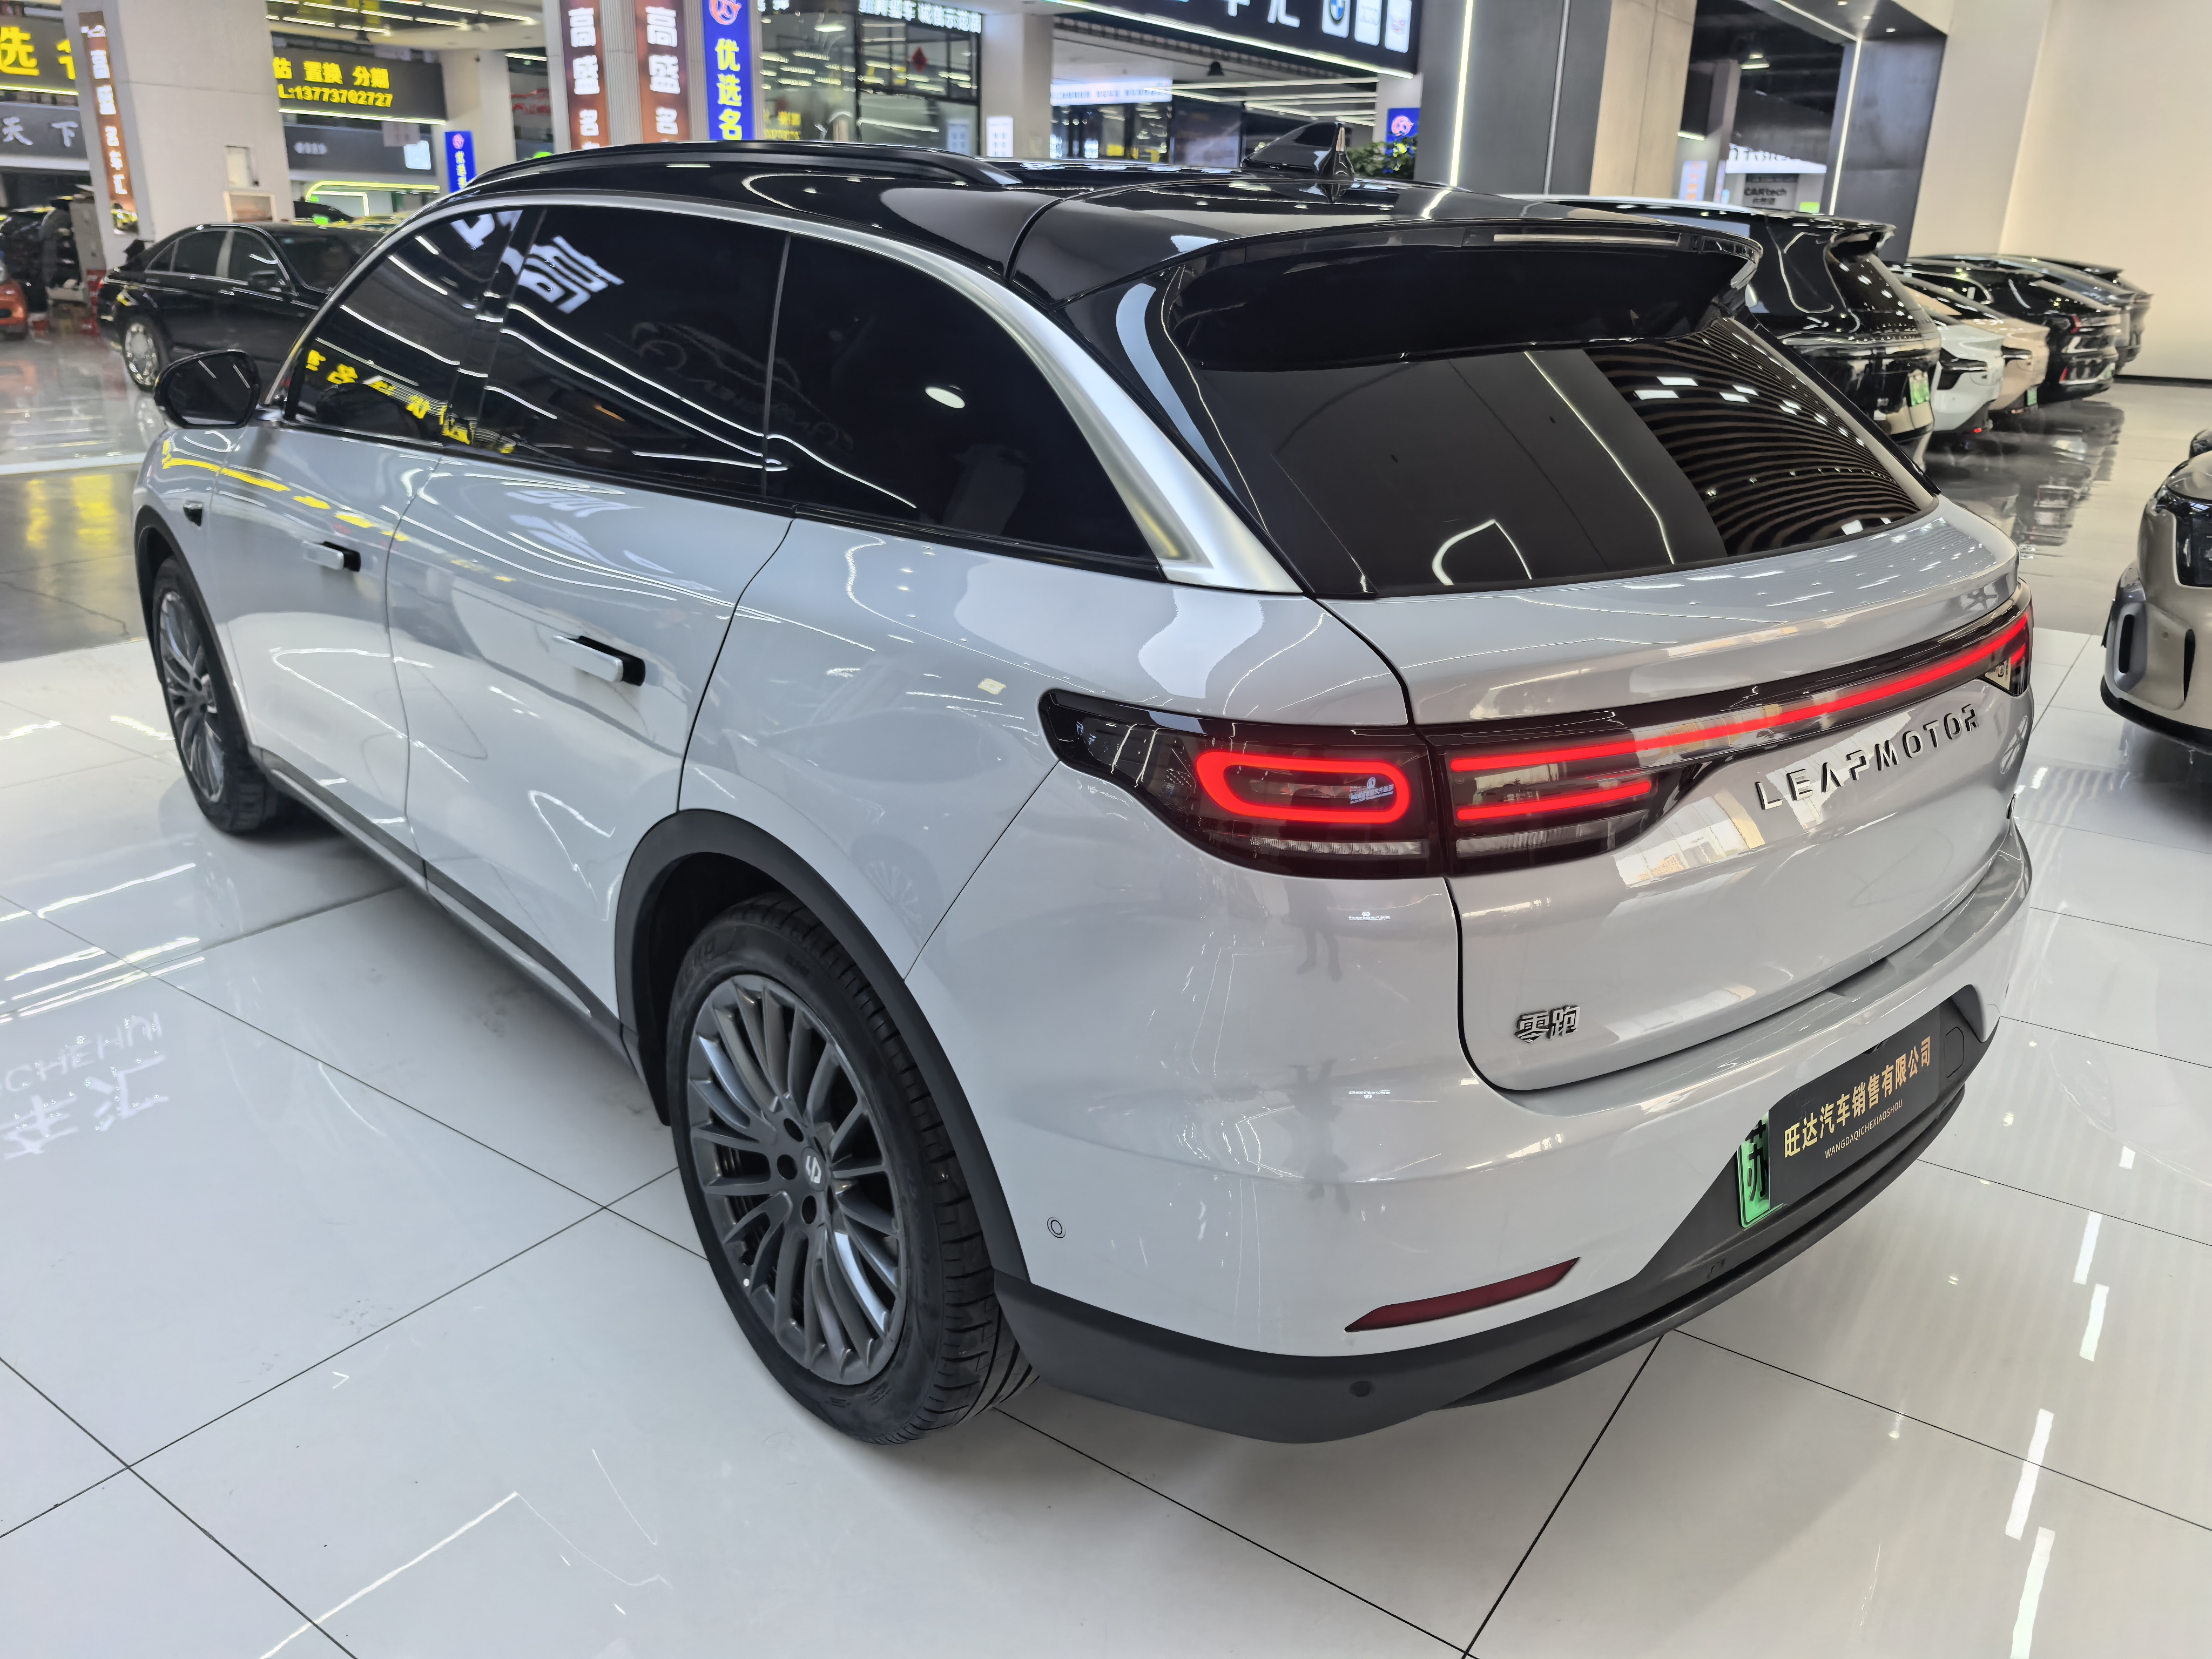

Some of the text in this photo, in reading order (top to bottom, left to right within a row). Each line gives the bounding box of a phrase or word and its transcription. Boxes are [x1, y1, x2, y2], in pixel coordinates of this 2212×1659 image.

[304, 61, 343, 85] 置换
[353, 65, 389, 89] 分期
[2, 117, 79, 147] 天下
[1754, 703, 1979, 811] LEAPMOTOR
[1514, 1004, 1581, 1044] 零跑
[1784, 1036, 1931, 1158] 旺达汽车销售有限公司
[1825, 1098, 1904, 1159] WANGDAQICHEXIAOSHOU
